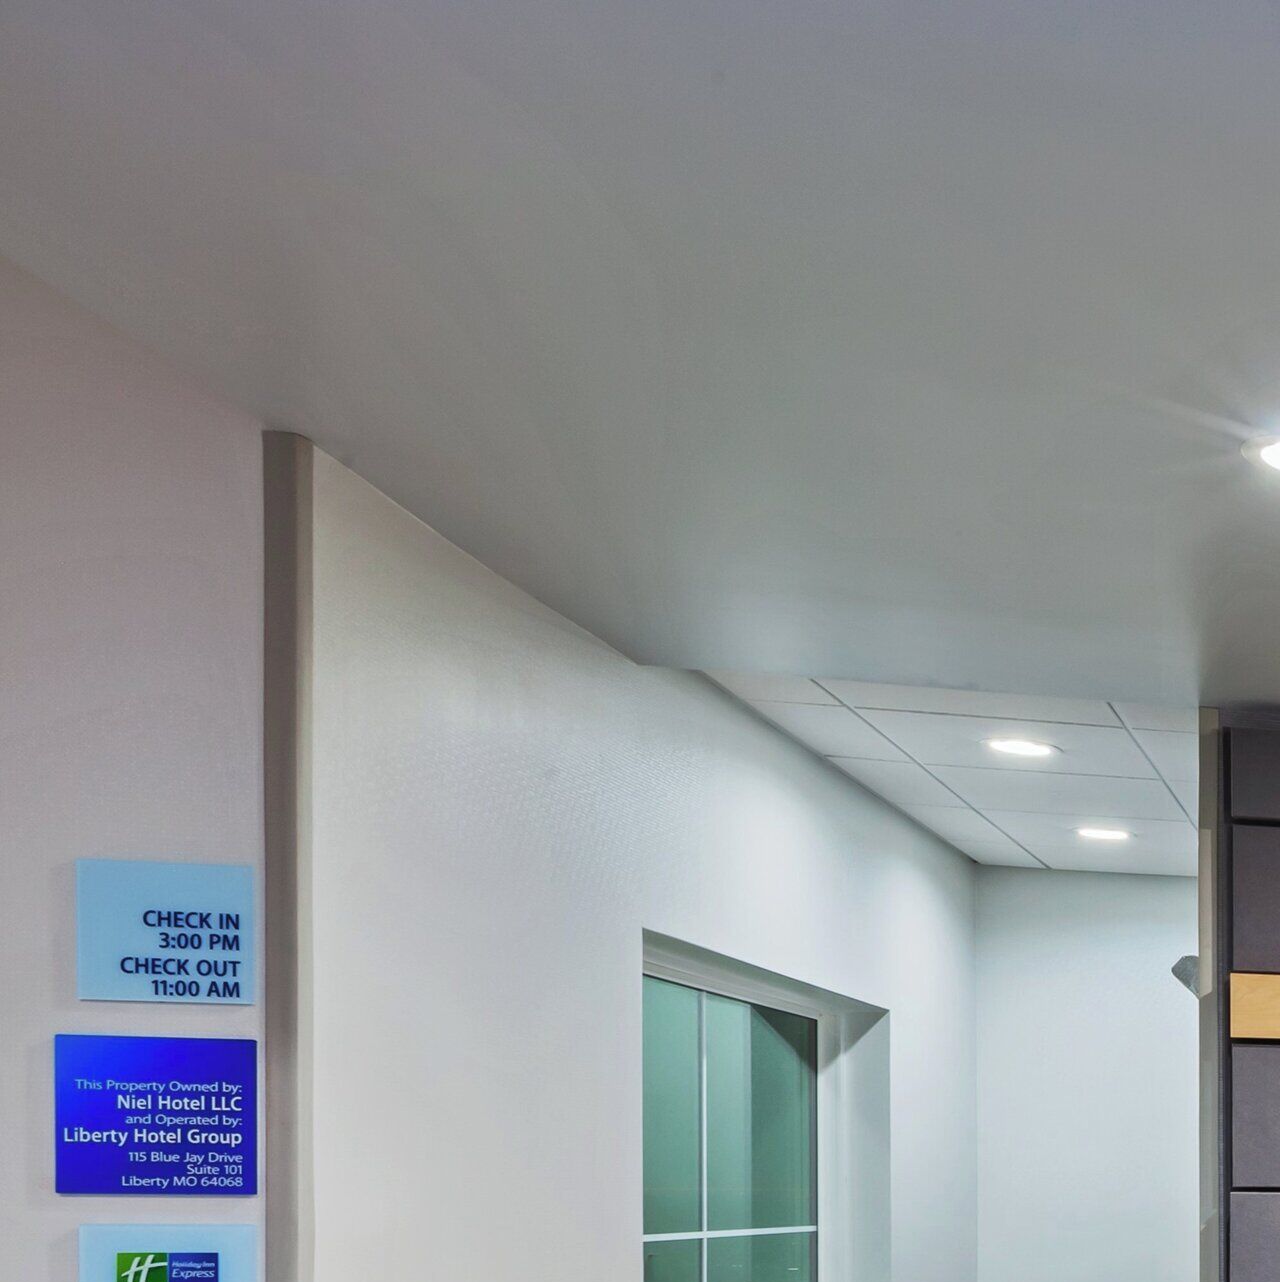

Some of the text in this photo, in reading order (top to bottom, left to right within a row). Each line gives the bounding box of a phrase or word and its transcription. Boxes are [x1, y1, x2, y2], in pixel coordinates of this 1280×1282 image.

[143, 910, 240, 930] CHECK IN
[159, 932, 240, 950] 3:00 PM
[120, 957, 240, 976] CHECK OUT
[151, 980, 240, 998] 11:00 AM
[75, 1079, 242, 1094] This Property Owned by:
[117, 1095, 242, 1112] Niel Hotel LLC
[125, 1114, 242, 1128] and Operated by:
[64, 1128, 242, 1147] Liberty Hotel Group
[128, 1152, 243, 1165] 115 Blue Jay Drive
[187, 1164, 242, 1175] Suite 101
[122, 1176, 243, 1188] Liberty MO 64068
[172, 1268, 215, 1279] Express
